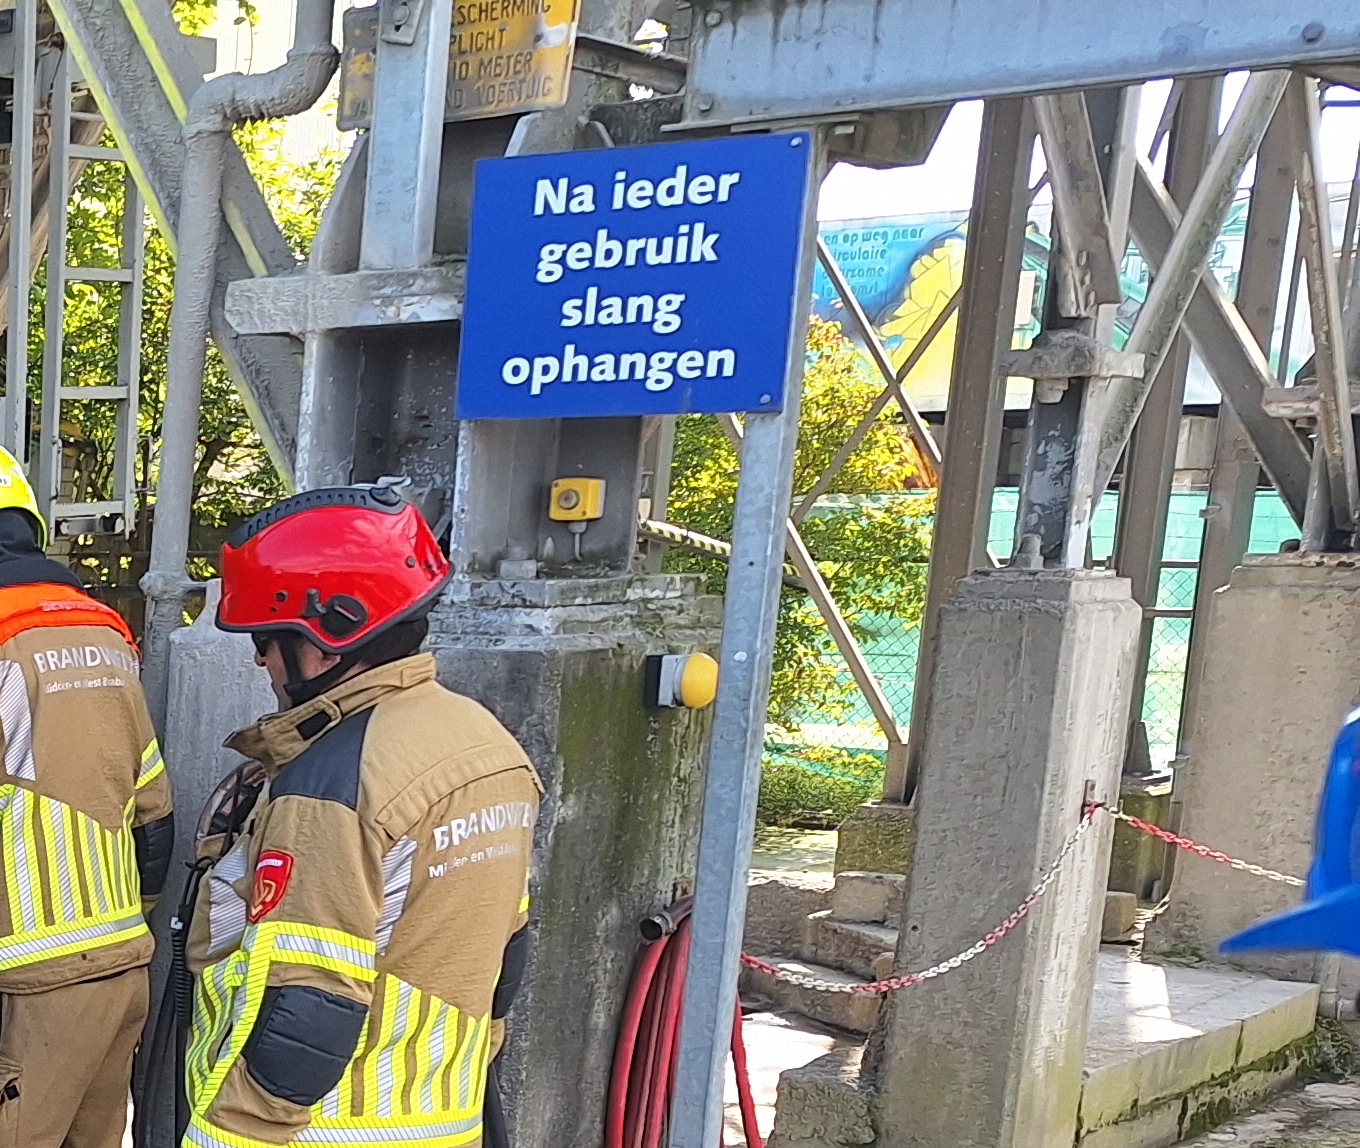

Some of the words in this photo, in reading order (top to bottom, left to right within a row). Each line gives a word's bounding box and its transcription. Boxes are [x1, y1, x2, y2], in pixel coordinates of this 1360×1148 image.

[478, 51, 534, 80] METER
[533, 177, 595, 216] Na
[612, 164, 740, 210] ieder
[536, 222, 720, 283] gebruik
[833, 245, 887, 262] irculaire
[842, 231, 858, 246] op
[862, 230, 888, 245] weg
[892, 227, 924, 241] naar
[560, 286, 685, 334] slang
[502, 344, 735, 396] ophangen
[471, 851, 484, 862] en
